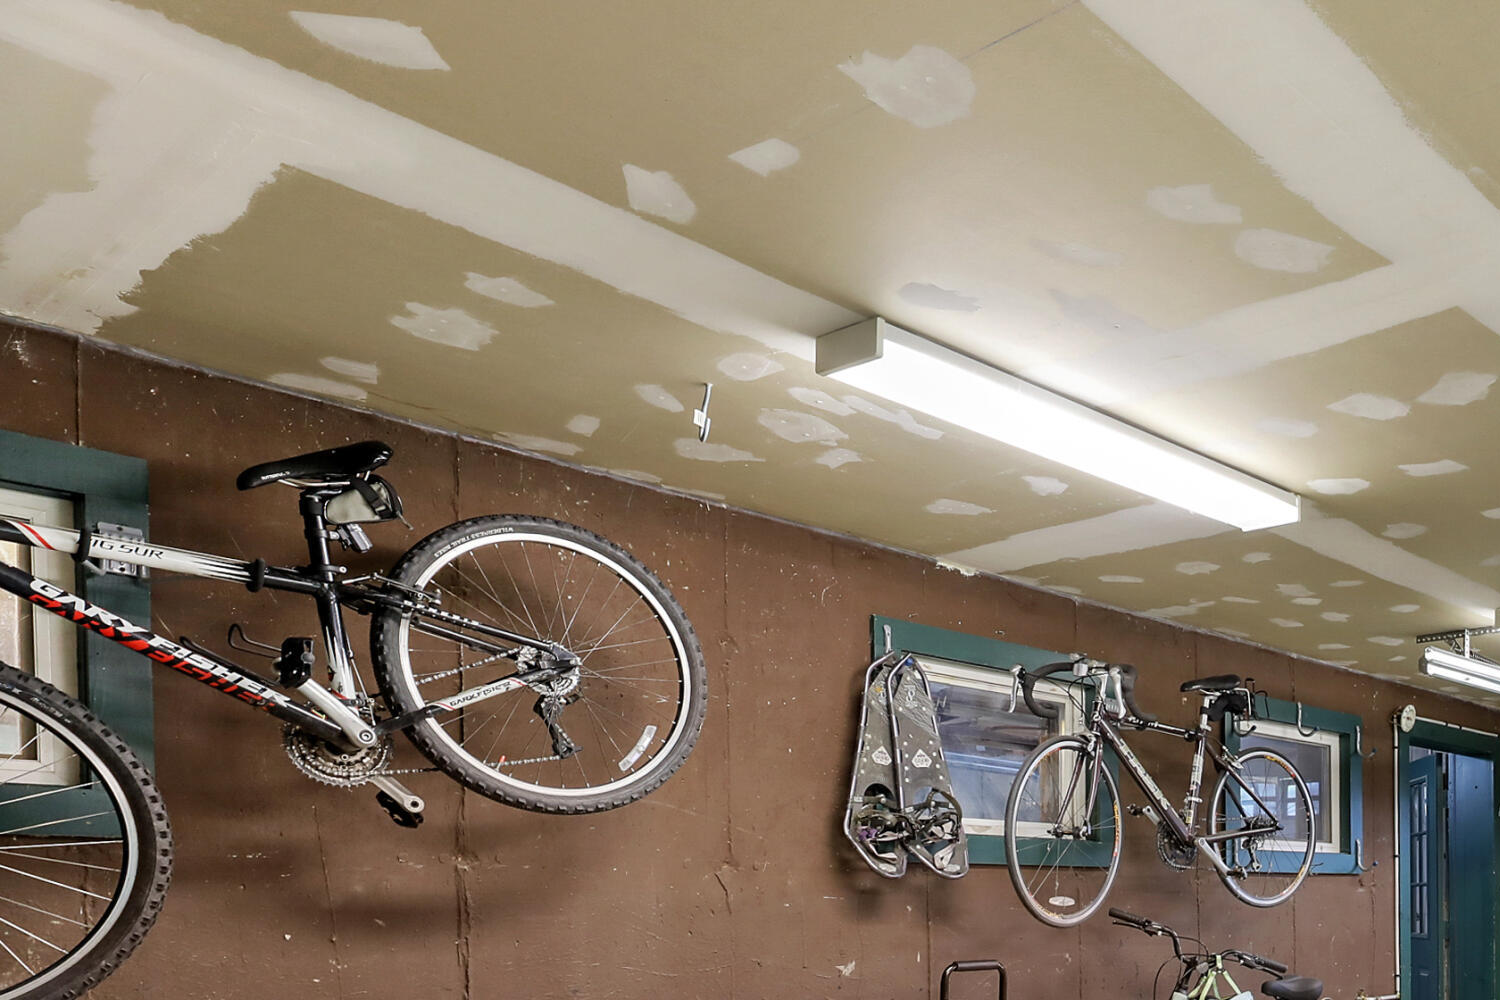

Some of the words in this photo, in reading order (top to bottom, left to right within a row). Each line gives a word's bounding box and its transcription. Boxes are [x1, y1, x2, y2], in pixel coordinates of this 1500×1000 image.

[92, 540, 115, 551] IG
[118, 544, 164, 559] SUR
[30, 578, 149, 634] GARY
[148, 634, 291, 708] FISHER
